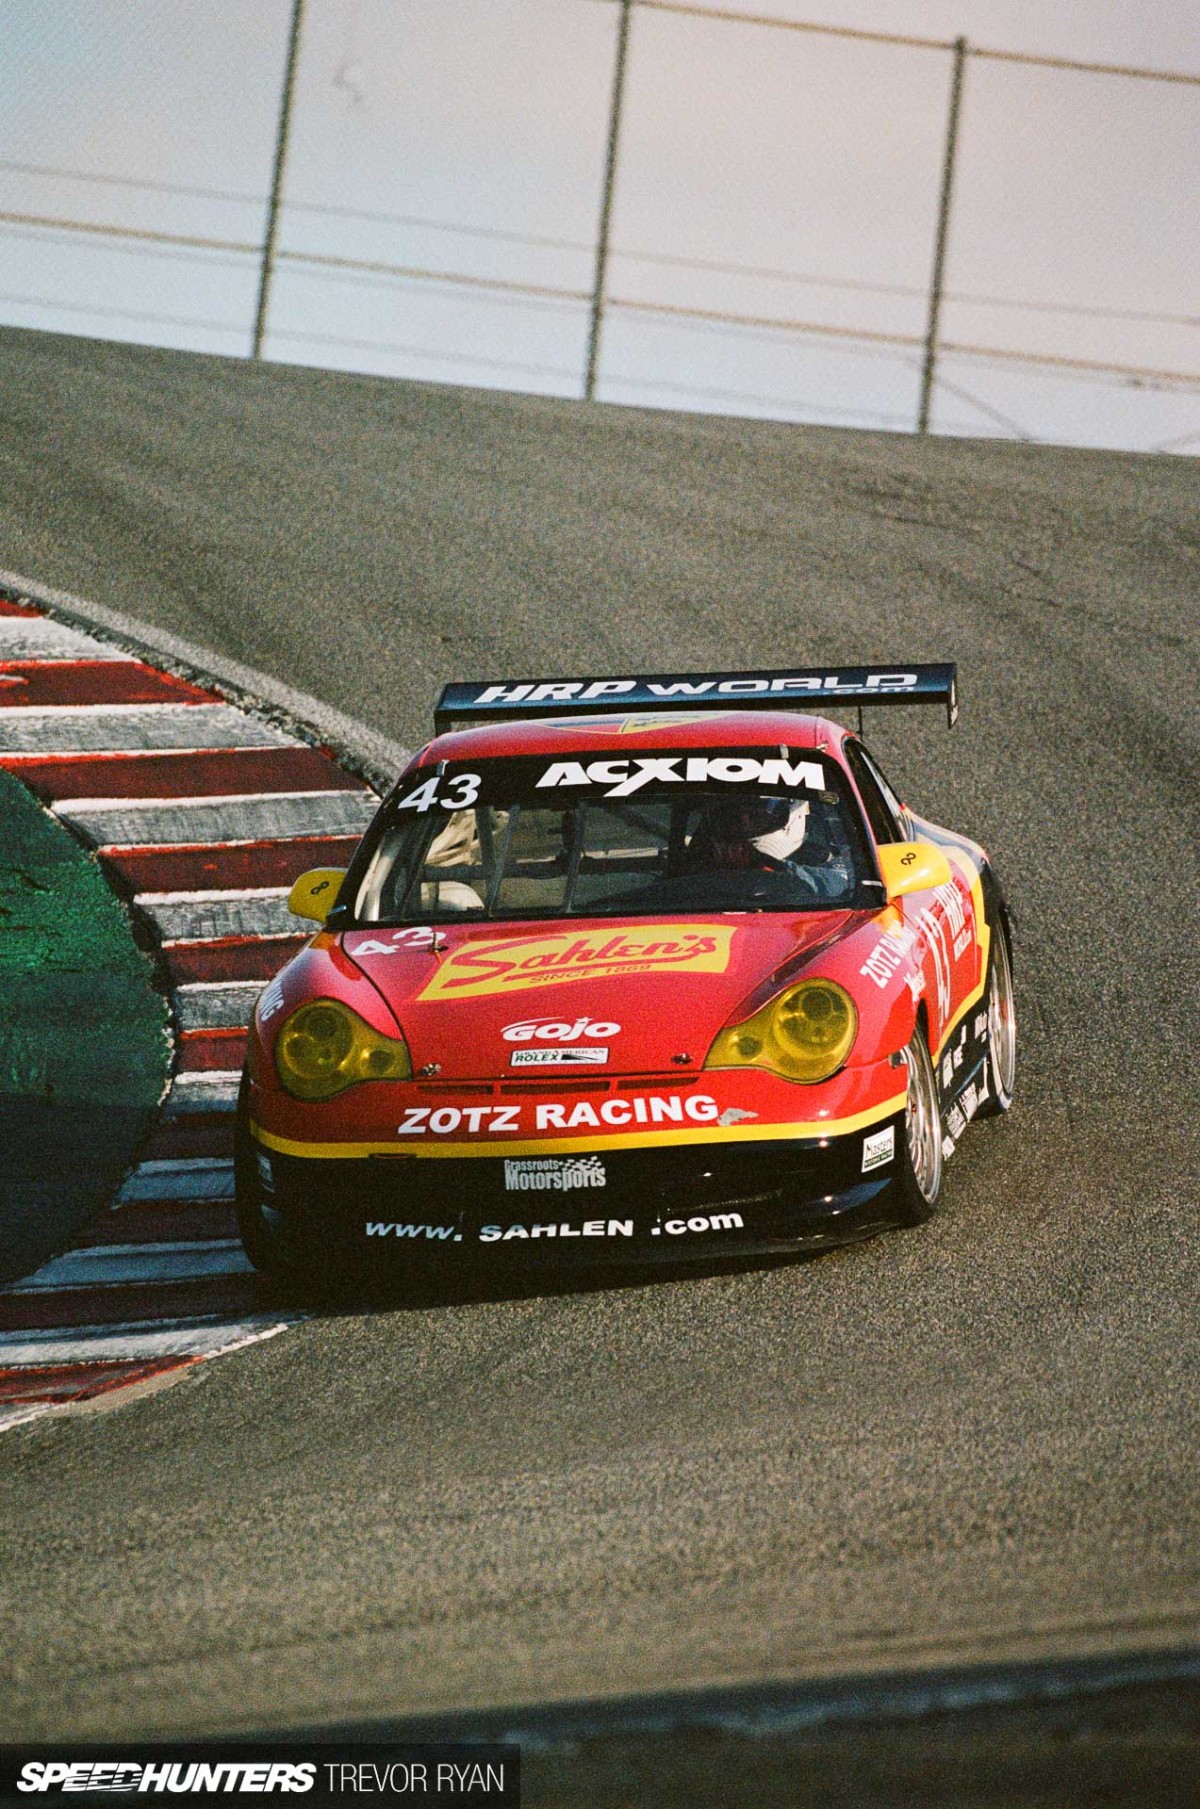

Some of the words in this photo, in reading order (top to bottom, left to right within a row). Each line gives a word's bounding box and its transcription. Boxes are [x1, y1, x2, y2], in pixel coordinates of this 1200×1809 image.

[474, 680, 636, 703] HRP
[646, 673, 918, 696] WORLD
[397, 773, 482, 812] 43
[535, 758, 825, 797] ACXIOM
[351, 926, 446, 956] 43
[440, 935, 717, 989] Sahlen's
[529, 968, 592, 984] SINCE
[603, 964, 651, 976] 1869
[859, 944, 902, 989] ZOTZ
[514, 1054, 558, 1063] ROLEX
[398, 1106, 522, 1134] ZOTZ
[535, 1095, 719, 1130] RACING
[505, 1165, 606, 1192] Motorsports
[366, 1221, 462, 1241] www.
[479, 1220, 633, 1242] SAHLEN
[651, 1212, 744, 1236] .com
